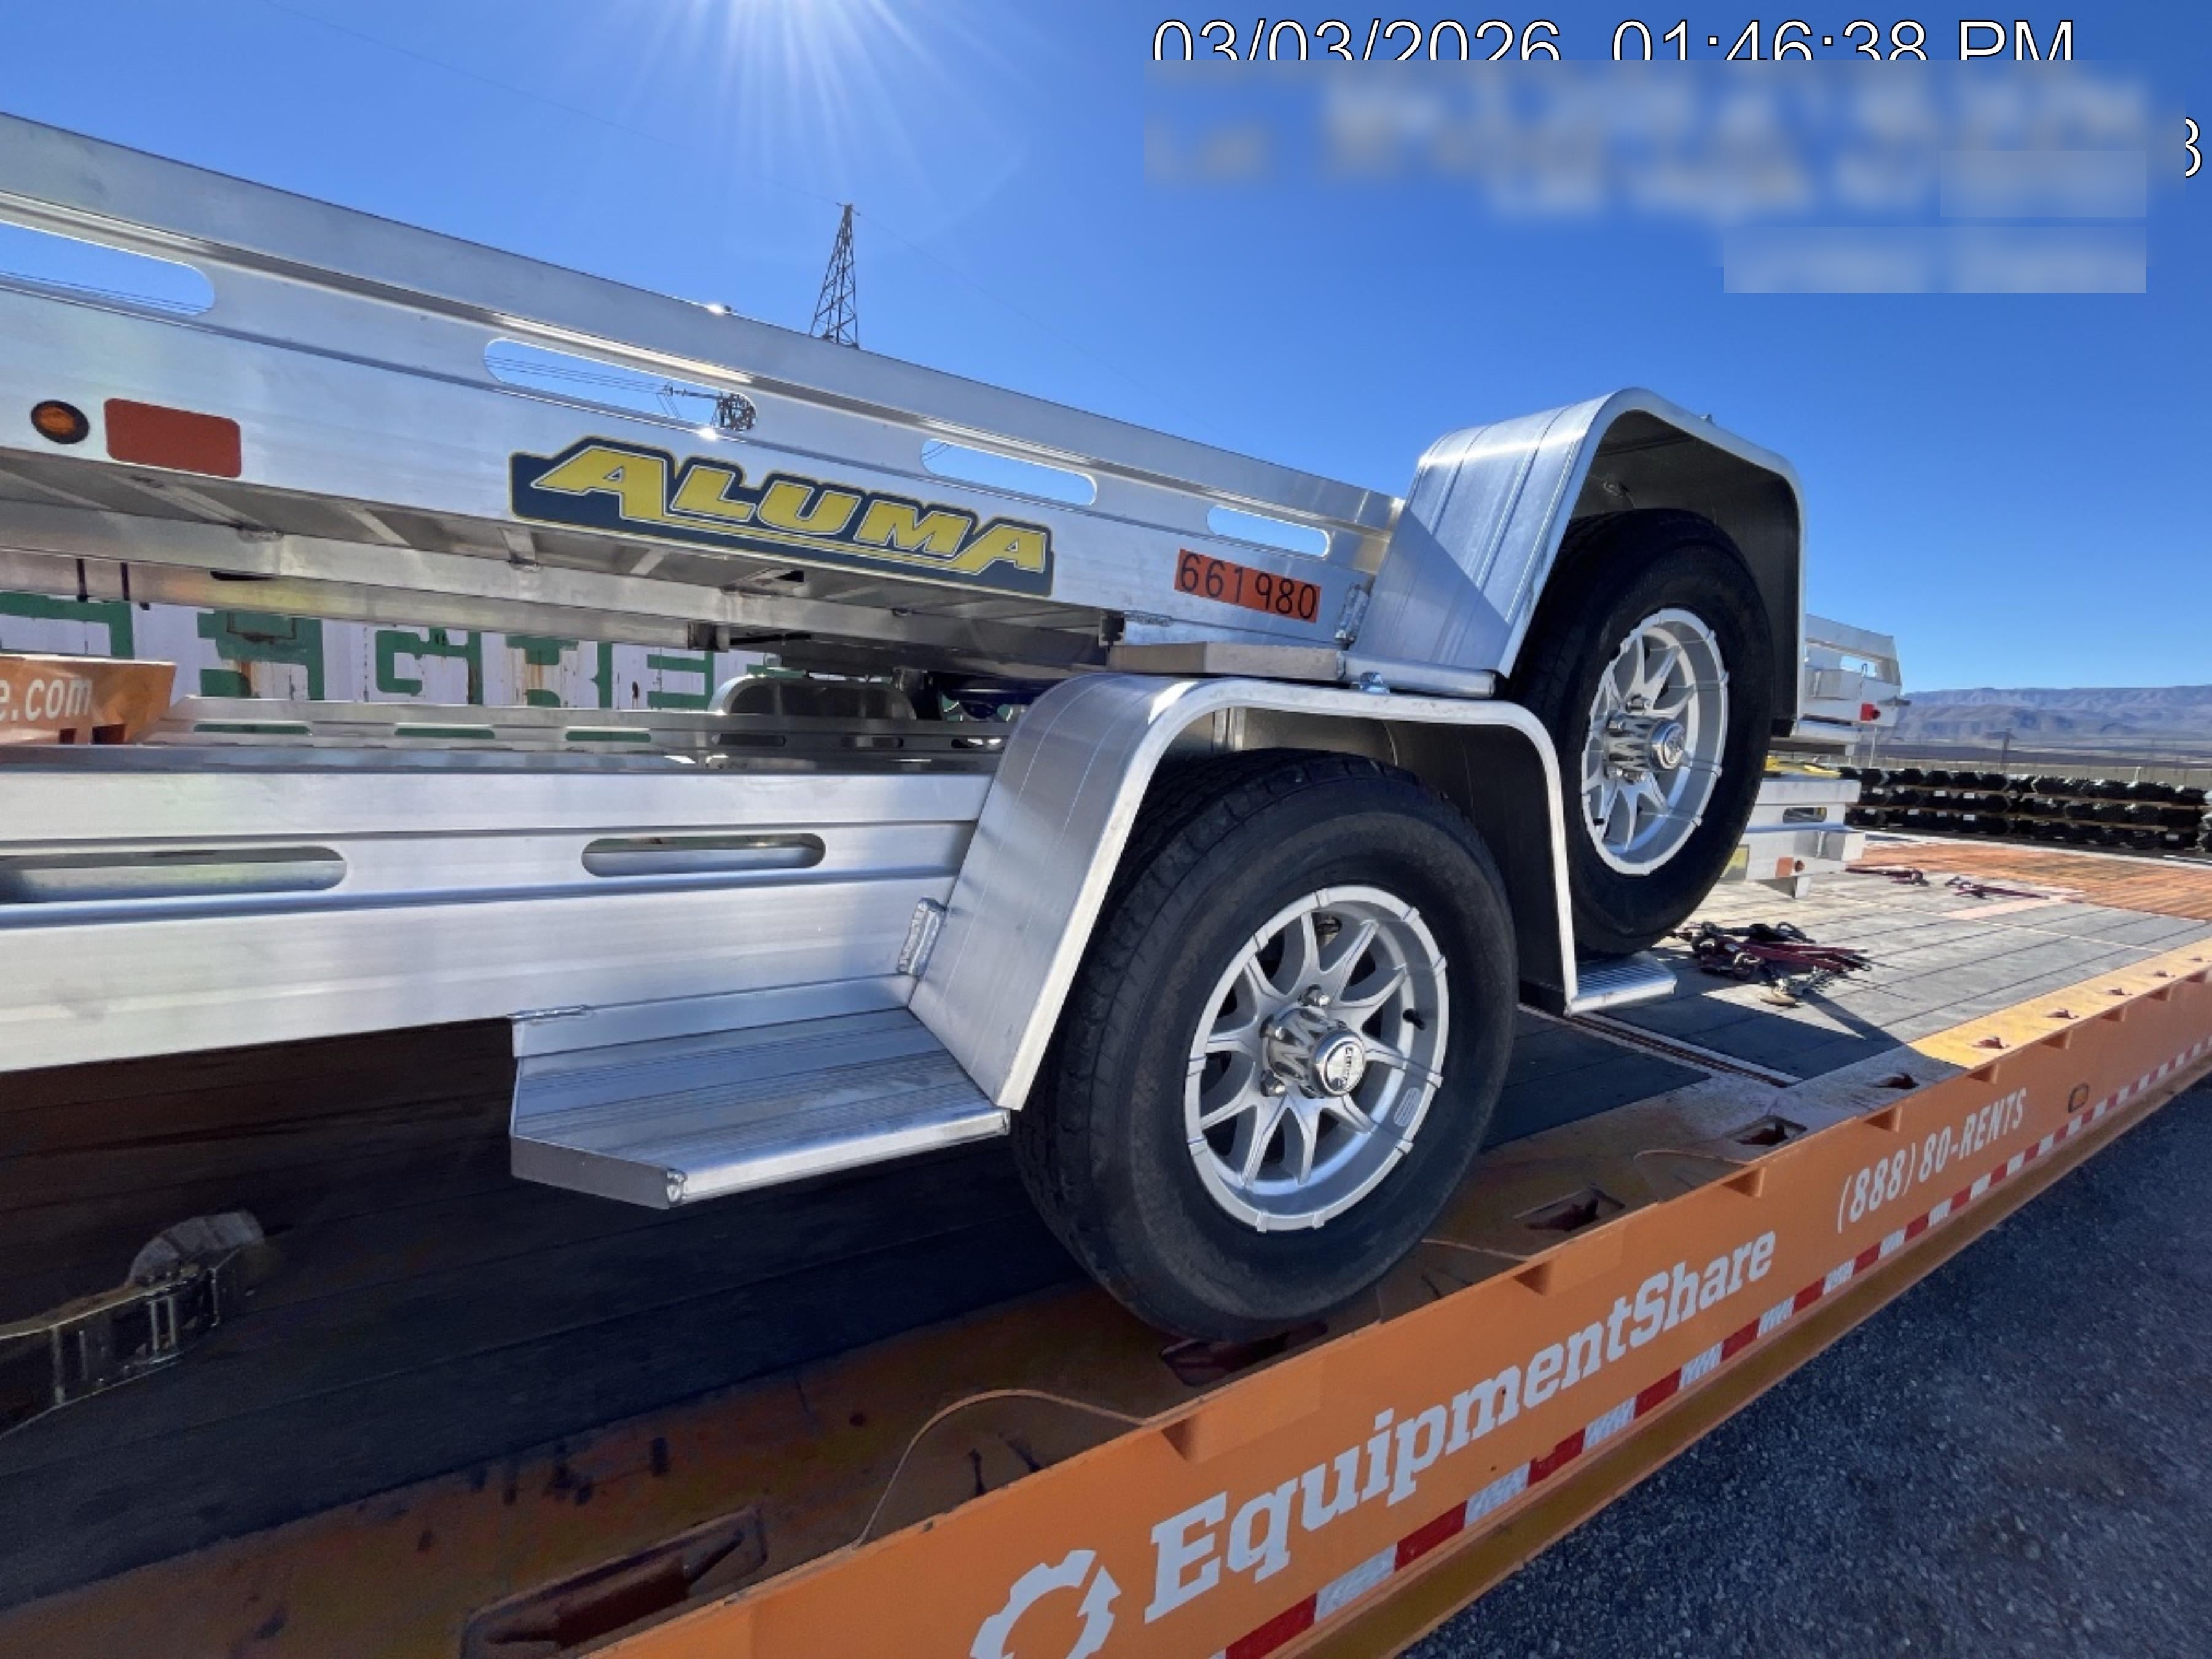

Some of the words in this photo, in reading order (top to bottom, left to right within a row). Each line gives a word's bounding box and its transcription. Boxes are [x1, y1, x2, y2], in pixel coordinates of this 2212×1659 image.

[531, 445, 1046, 574] ALUMA
[1180, 552, 1317, 619] 661980
[1837, 1142, 1916, 1234] (888)
[1918, 1087, 2027, 1183] 80-RENTS
[1143, 1231, 1776, 1625] EquipmentShare
